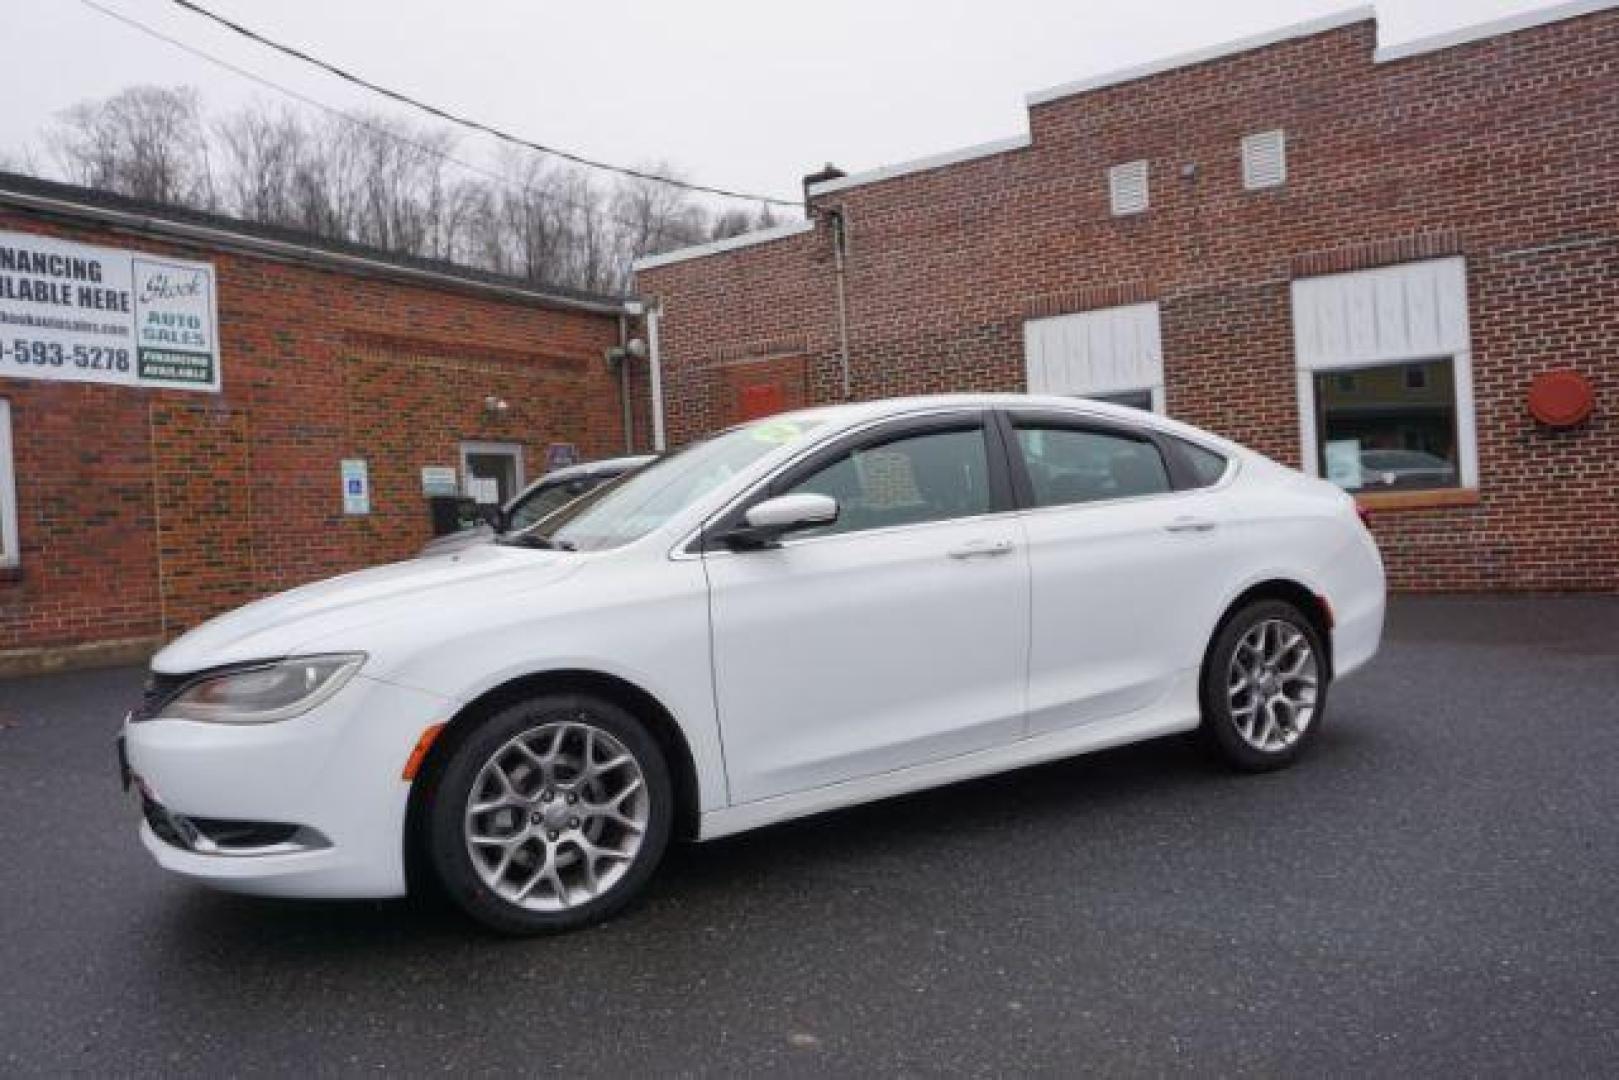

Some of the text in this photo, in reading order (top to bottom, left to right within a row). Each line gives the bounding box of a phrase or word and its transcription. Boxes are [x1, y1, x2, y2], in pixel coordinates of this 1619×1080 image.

[78, 285, 130, 313] HERE
[147, 310, 201, 329] AUTO
[142, 328, 206, 345] SALES
[0, 338, 130, 373] -593-5278
